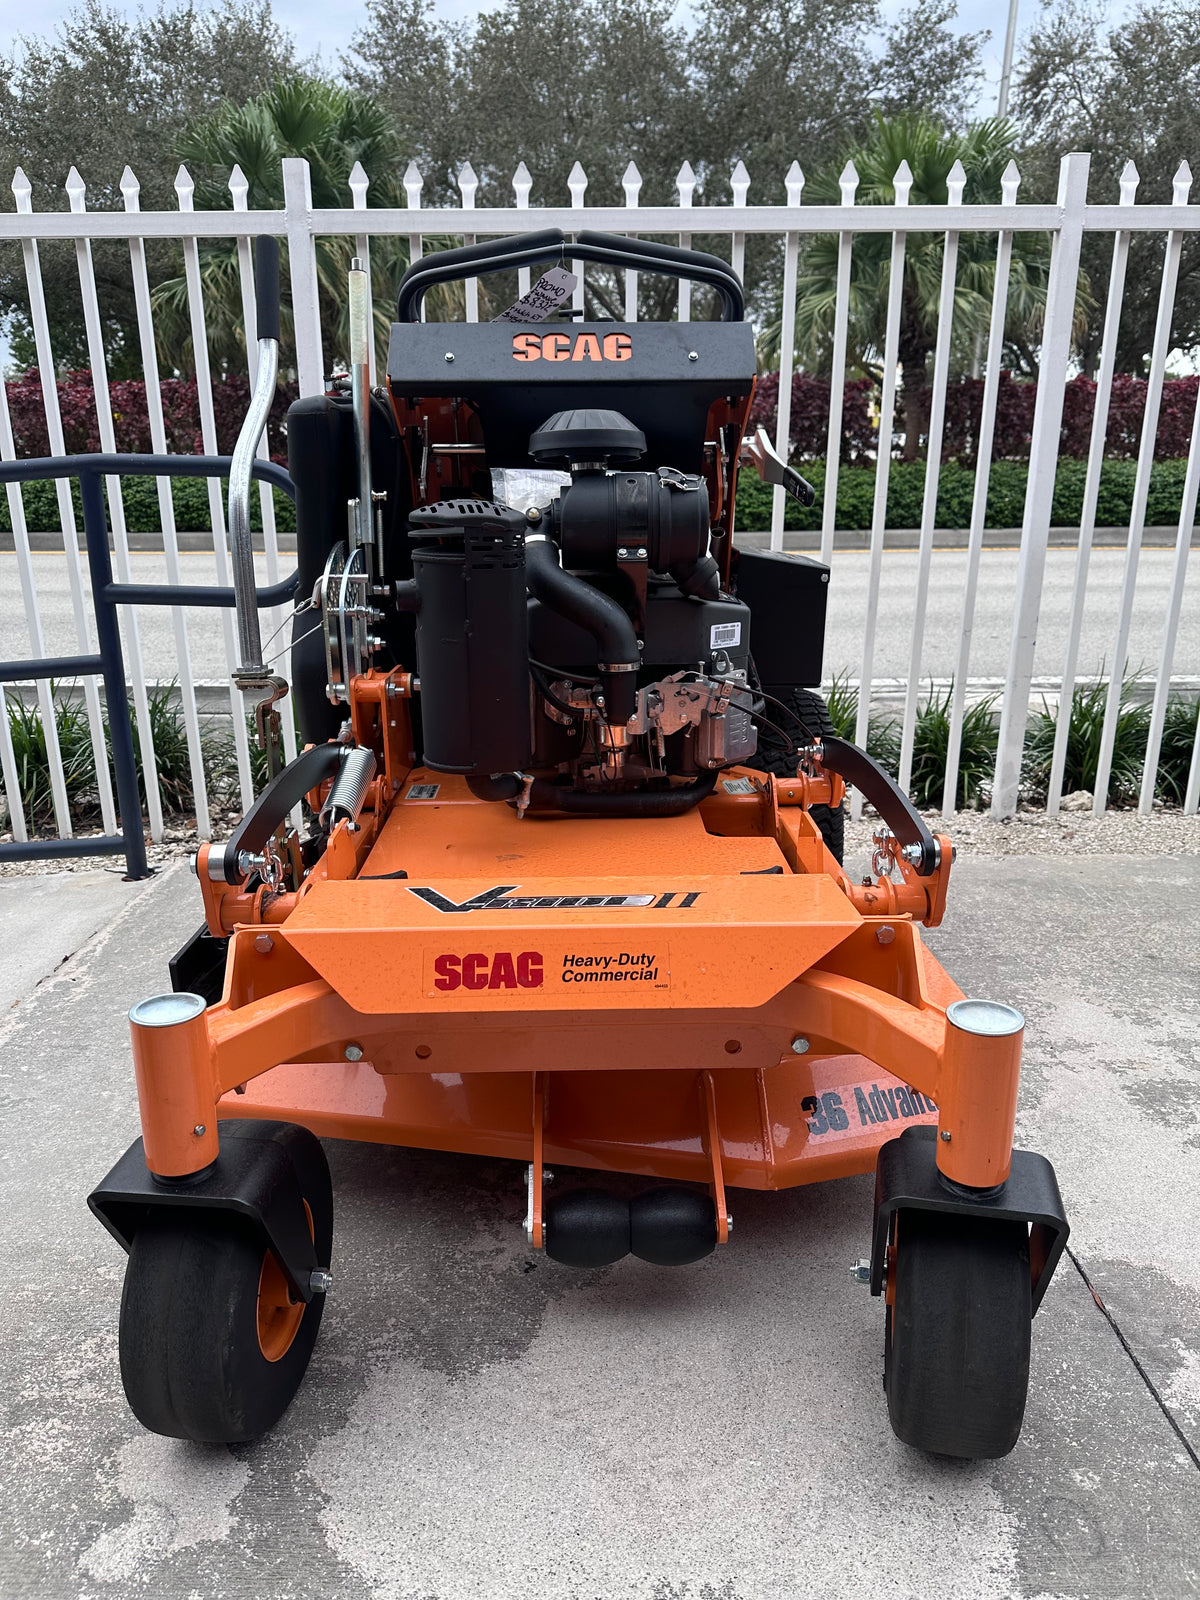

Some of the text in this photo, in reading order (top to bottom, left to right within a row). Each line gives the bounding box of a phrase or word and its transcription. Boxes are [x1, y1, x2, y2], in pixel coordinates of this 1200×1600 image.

[512, 332, 632, 361] SCAG
[434, 951, 656, 991] SCAG Heavy-Duty
[561, 967, 658, 983] Commercial
[801, 1092, 849, 1135] 36
